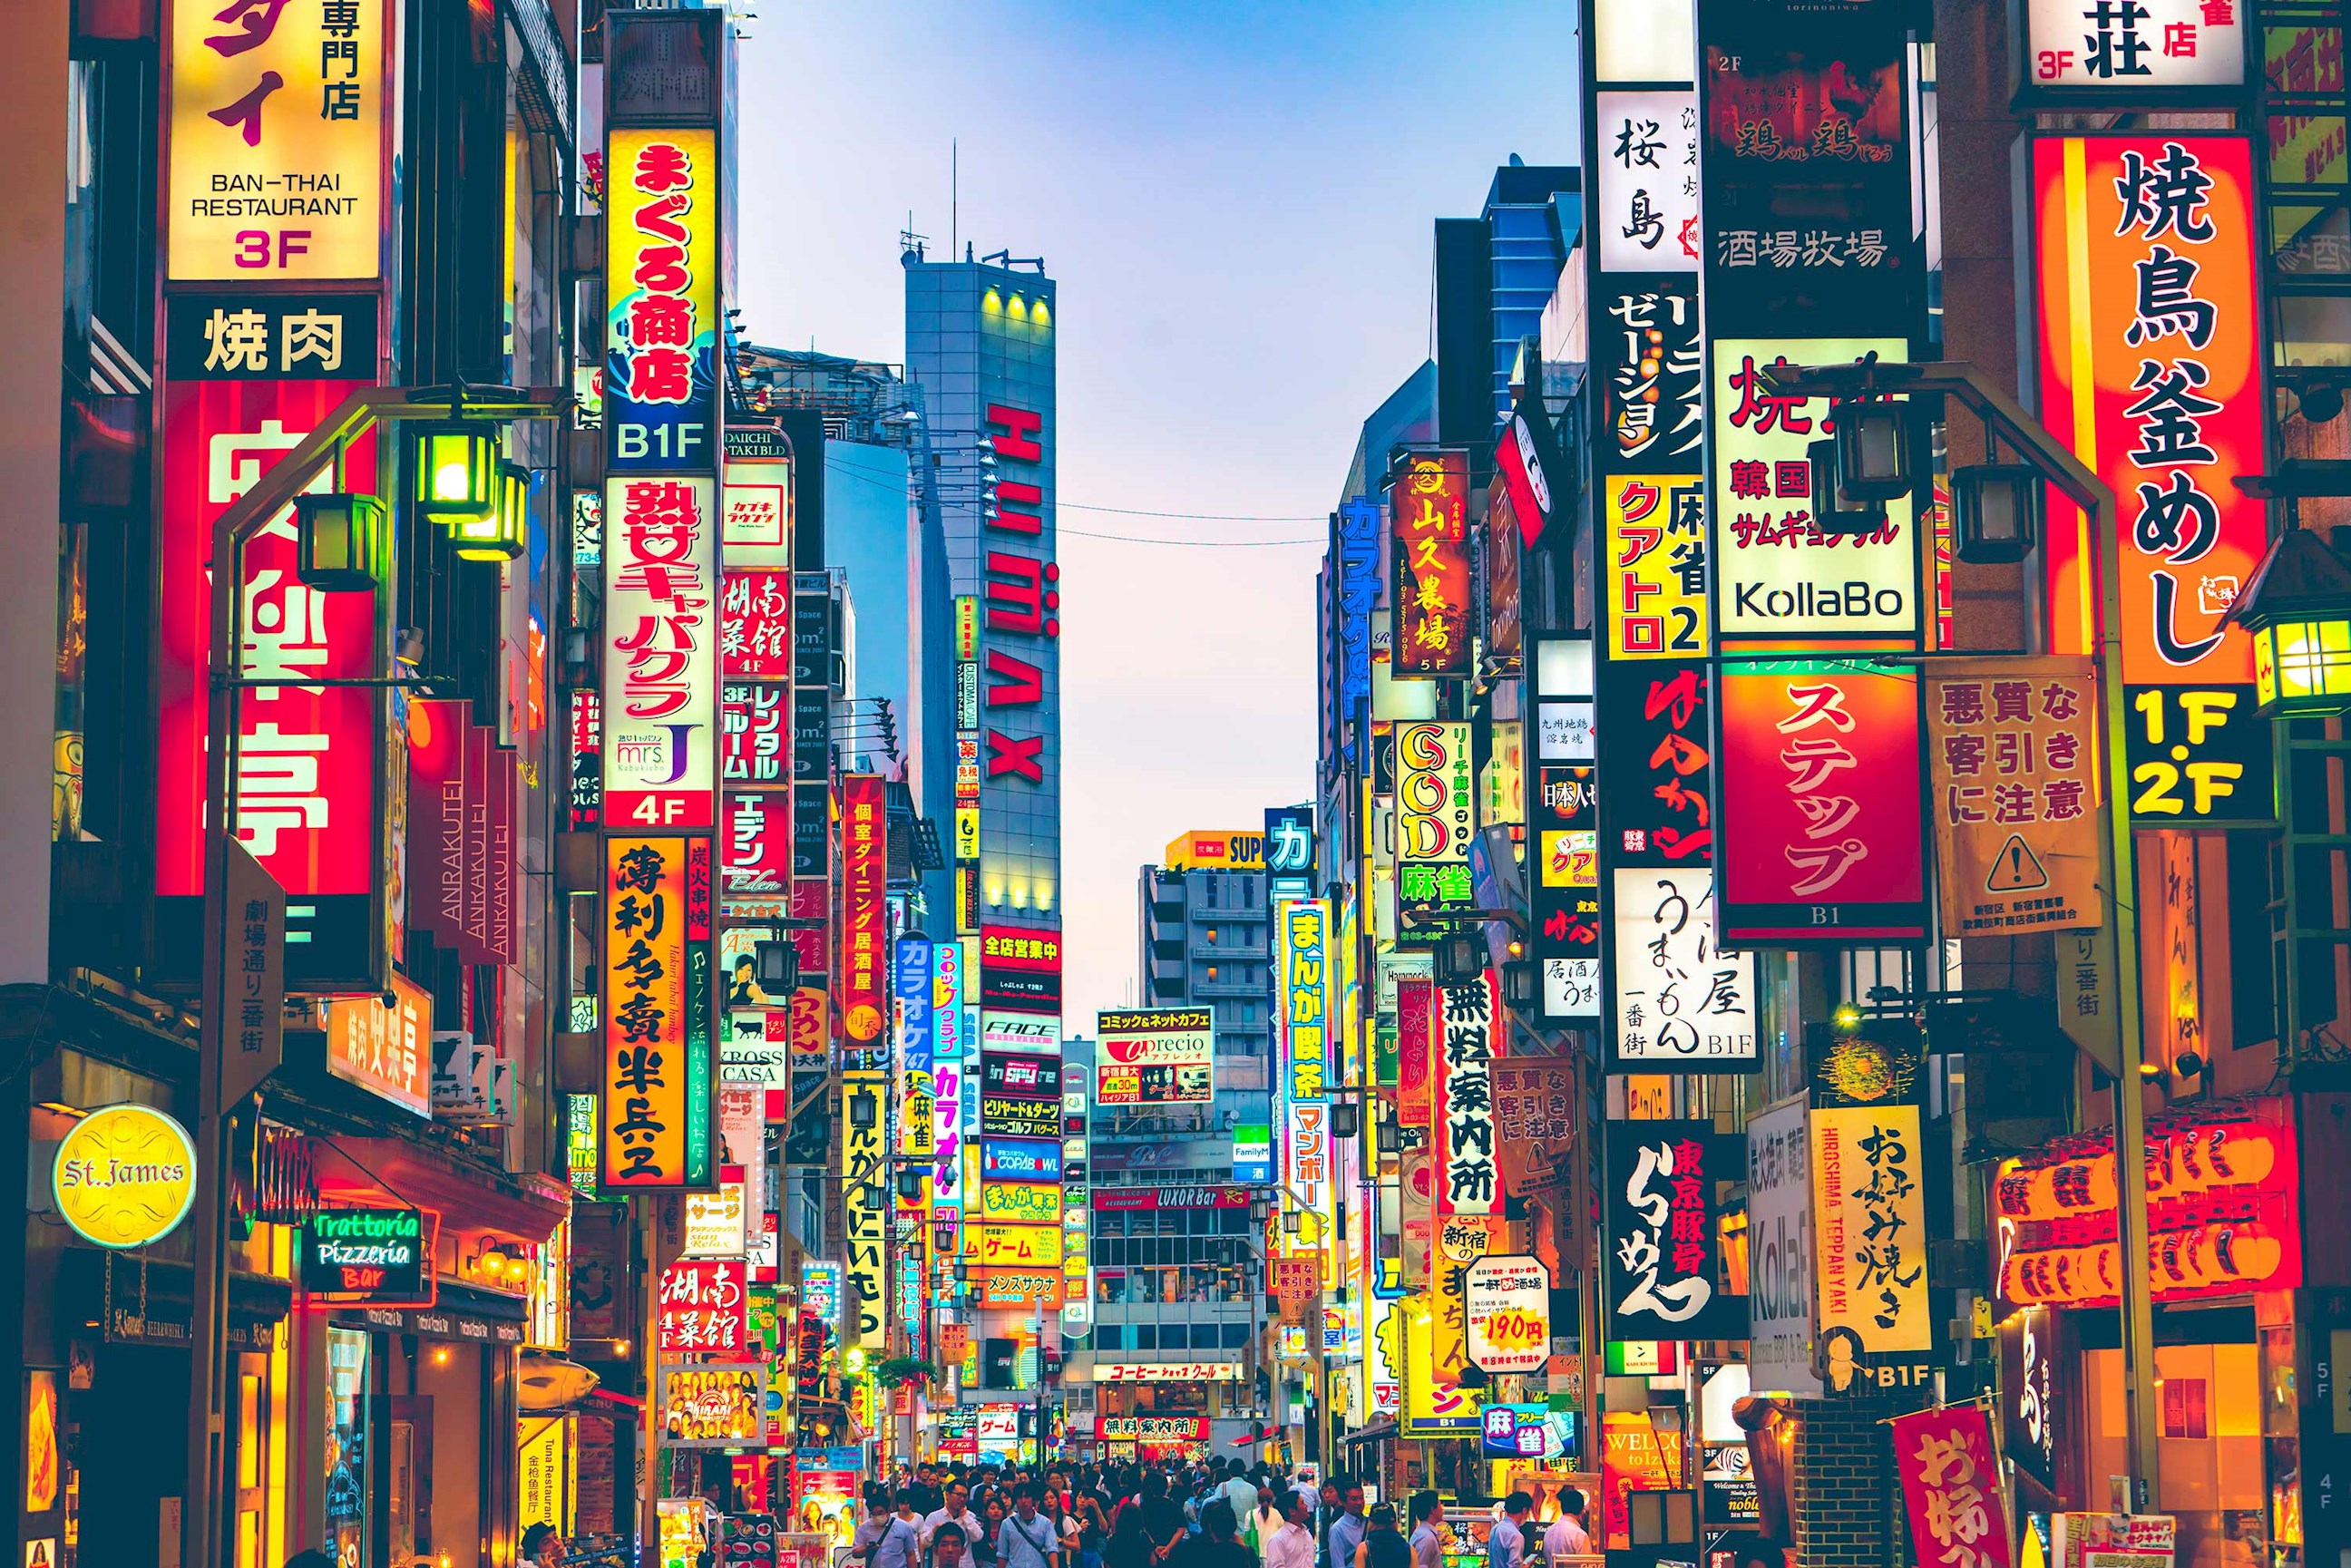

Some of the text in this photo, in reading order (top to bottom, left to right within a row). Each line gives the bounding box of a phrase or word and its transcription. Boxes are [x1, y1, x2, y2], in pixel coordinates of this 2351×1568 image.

[2083, 0, 2151, 79] 荘
[321, 0, 360, 121] 専門店
[1719, 55, 1741, 72] 2F
[2038, 50, 2074, 80] 3F
[211, 173, 340, 192] BAN-THAI
[1613, 118, 1667, 250] 桜島
[191, 198, 358, 217] RESTAURANT
[234, 230, 312, 269] 3F
[1718, 229, 1888, 268] 酒場牧場
[630, 143, 694, 404] まぐろ商店
[203, 308, 343, 372] 焼肉
[1609, 293, 1660, 460] ゼーション
[2113, 141, 2226, 667] 焼鳥釜めし
[617, 423, 704, 458] B1F
[760, 445, 785, 455] BLD
[727, 512, 776, 523] ラウンジ
[734, 501, 773, 511] カブキ
[1412, 498, 1450, 650] 山久農場
[1618, 482, 1663, 653] クアトロ
[614, 481, 708, 721] 熟女キャバクラ
[723, 575, 786, 618] 湖南
[1735, 580, 1903, 618] KollaBo
[739, 660, 764, 673] 4F
[1420, 658, 1447, 670] 5F
[725, 687, 749, 703] 3F
[1940, 681, 2079, 726] 悪質な
[755, 686, 778, 780] レンタル
[1541, 717, 1588, 730] 九州地鶏
[724, 710, 748, 779] ルーム
[959, 744, 978, 758] 薬
[1945, 731, 2080, 776] 客引き
[959, 766, 978, 777] 免税
[1400, 724, 1449, 859] GOD
[1452, 727, 1469, 856] リーチ麻雀 ゴッド
[1776, 681, 1868, 896] ステップ
[1946, 779, 2085, 826] に注意
[2133, 763, 2244, 815] 2F
[632, 794, 686, 825] 4F
[733, 794, 766, 864] エデン
[441, 781, 462, 922] ANRAKUTEI
[466, 804, 485, 940] ANRAKUTEI
[728, 869, 782, 891] Eden
[1400, 864, 1473, 901] 麻雀
[489, 826, 507, 957] ANRAKUTEI
[854, 803, 873, 990] 個室ダイニング居酒屋
[1810, 906, 1840, 925] B1
[1974, 903, 2005, 916] 新宿区
[985, 935, 1058, 961] 全店営業中
[239, 899, 268, 1054] 劇場通り一番街
[670, 945, 679, 984] Hakuri
[1647, 879, 1699, 1055] うまいもん
[902, 940, 929, 1049] カラオケ
[963, 1012, 976, 1057] SEGA
[986, 1021, 1058, 1037] FACE
[1100, 1013, 1209, 1029] コミック&ネットカフェ
[1624, 989, 1647, 1056] 一番街
[1126, 1034, 1205, 1061] aprecio
[1289, 909, 1324, 1208] まんが喫茶 マンボー
[1708, 1035, 1752, 1055] B1F
[723, 1066, 776, 1082] CASA
[1100, 1066, 1139, 1077] 新宿最大
[1496, 1070, 1566, 1092] 悪質な
[1100, 1093, 1140, 1102] ハイジアB1
[1446, 975, 1494, 1203] 無料案内所
[691, 1079, 707, 1158] 楽しいお店
[963, 1082, 976, 1127] SEGA
[983, 1099, 1060, 1121] ビリヤード&ダーツ
[1497, 1095, 1567, 1117] 客引き
[913, 1096, 930, 1148] 麻雀
[1007, 1121, 1032, 1135] ゴルフ
[1502, 1118, 1569, 1142] に注意
[1252, 1167, 1264, 1179] 酒
[1820, 1127, 1842, 1209] HIROSHIMA
[985, 1184, 1058, 1211] まんが喫茶
[1157, 1188, 1195, 1207] LUXOR
[1195, 1187, 1218, 1207] Bar
[1671, 1137, 1707, 1274] 東京豚骨
[1443, 1224, 1488, 1261] 新宿 の
[1851, 1125, 1923, 1330] お好み焼き
[986, 1238, 1032, 1259] ゲーム
[341, 1267, 385, 1289] Bar
[1279, 1263, 1313, 1275] 悪質な
[1279, 1276, 1314, 1288] 客引き
[1472, 1277, 1542, 1291] 一軒め酒場
[659, 1263, 740, 1307] 湖南
[988, 1276, 1056, 1293] メンズサウナ
[1280, 1289, 1314, 1300] に注意
[1488, 1314, 1543, 1340] 190円
[1110, 1365, 1157, 1379] コーヒー
[1193, 1364, 1216, 1379] クール
[1702, 1366, 1715, 1375] 5F
[1878, 1365, 1929, 1388] B1F
[982, 1420, 1015, 1433] ゲーム
[1105, 1418, 1191, 1433] 無料案内所
[1439, 1418, 1456, 1427] B1
[1516, 1411, 1545, 1423] フリー
[1629, 1451, 1643, 1466] to
[1704, 1449, 1717, 1458] 3F
[528, 1455, 540, 1514] 金枪鱼餐厅
[544, 1439, 555, 1524] Tuna Restaurant
[1706, 1532, 1719, 1541] 1F
